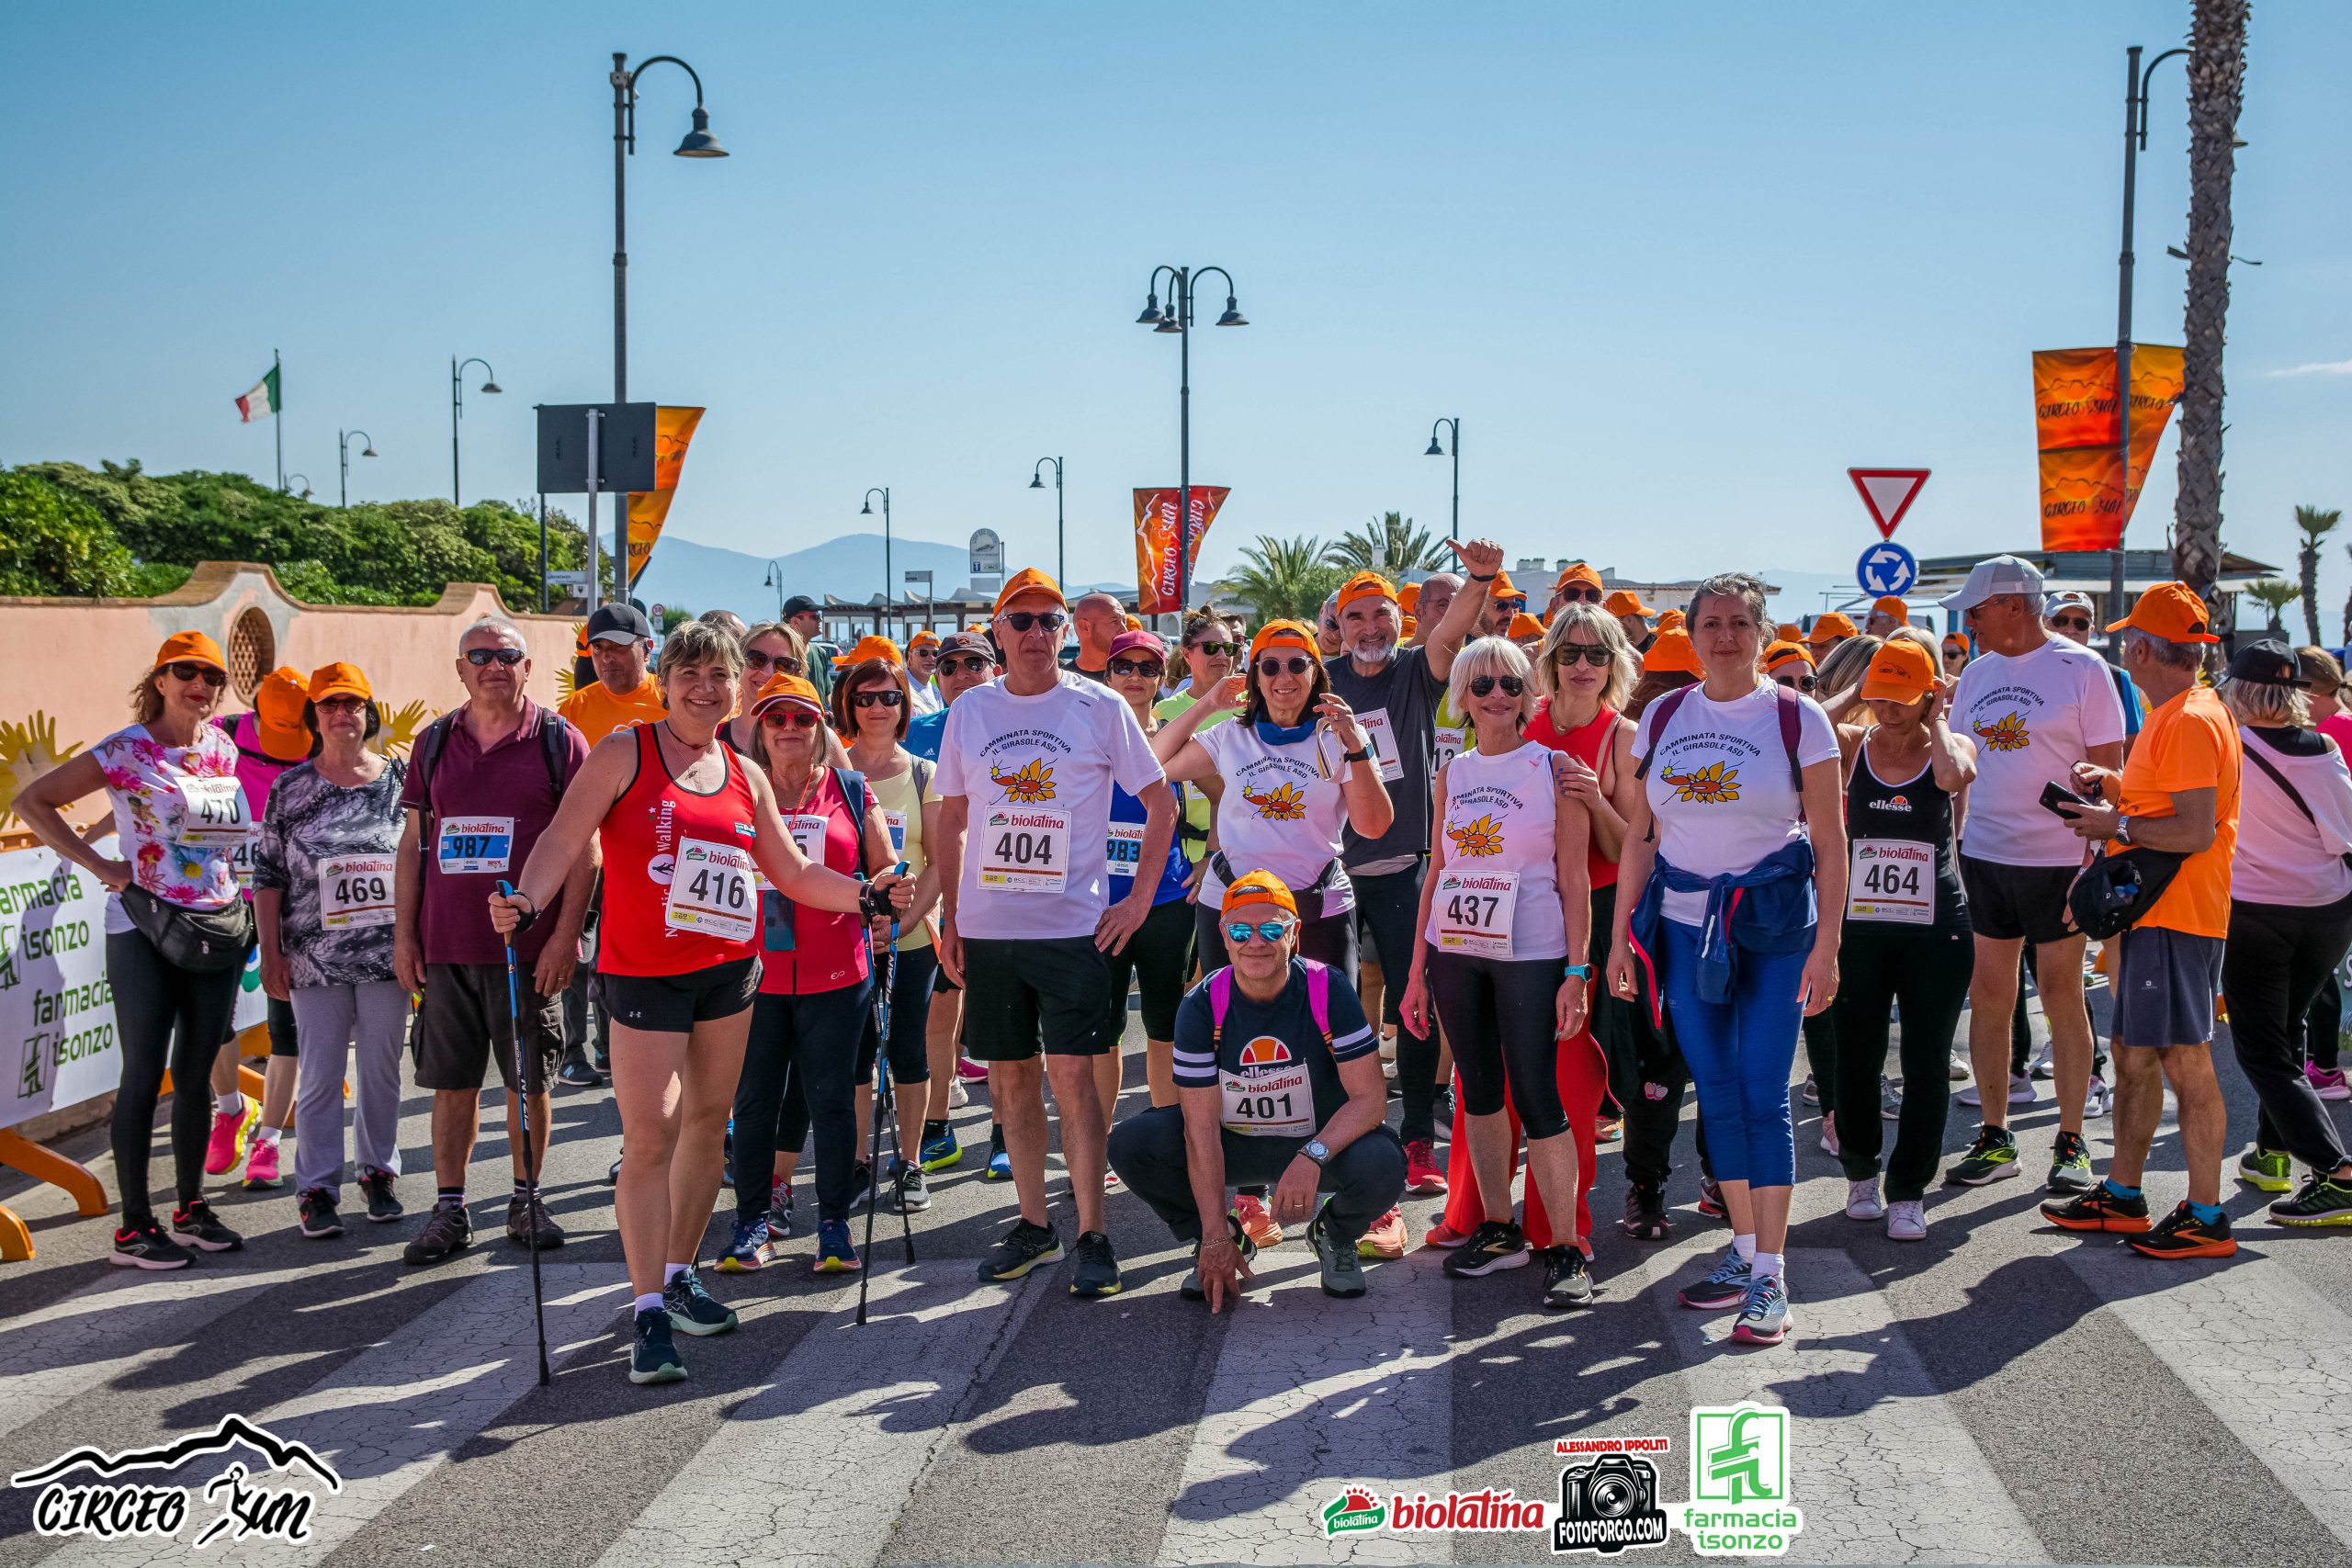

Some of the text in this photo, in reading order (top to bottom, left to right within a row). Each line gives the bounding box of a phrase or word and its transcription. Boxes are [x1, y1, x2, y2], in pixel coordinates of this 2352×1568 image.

[1970, 686, 2044, 713] CAMMINATA SPORTIVA
[1985, 694, 2019, 706] GIRASOLE
[2018, 696, 2031, 706] ASD
[979, 729, 1072, 757] CAMMINATA SPORTIVA
[991, 738, 1057, 756] IL GIRASOLE ASD
[1434, 733, 1462, 745] olatina
[1659, 732, 1761, 757] CAMMINATA SPORTIVA
[1683, 741, 1726, 751] GIRASOLE
[1726, 745, 1745, 757] ASD
[1236, 755, 1320, 779] CAMMINATA SPORTIVA
[1258, 762, 1292, 773] GIRASOLE
[1292, 768, 1307, 779] ASD
[1460, 795, 1494, 806] GIRASOLE
[1494, 797, 1509, 809] ASD
[1486, 785, 1523, 809] SPORTIVA
[1869, 799, 1912, 812] ellesse
[200, 797, 241, 825] 470
[656, 800, 676, 852] Walking
[1114, 829, 1144, 840] biolati
[453, 836, 492, 859] 987
[994, 832, 1053, 865] 404
[1106, 840, 1142, 863] 983
[0, 867, 84, 916] armacia
[335, 876, 387, 905] 469
[688, 868, 746, 909] 416
[1863, 863, 1920, 896] 464
[1447, 895, 1499, 928] 437
[21, 919, 89, 961] isonzo
[52, 1021, 113, 1068] isonzo
[1236, 1092, 1293, 1119] 401
